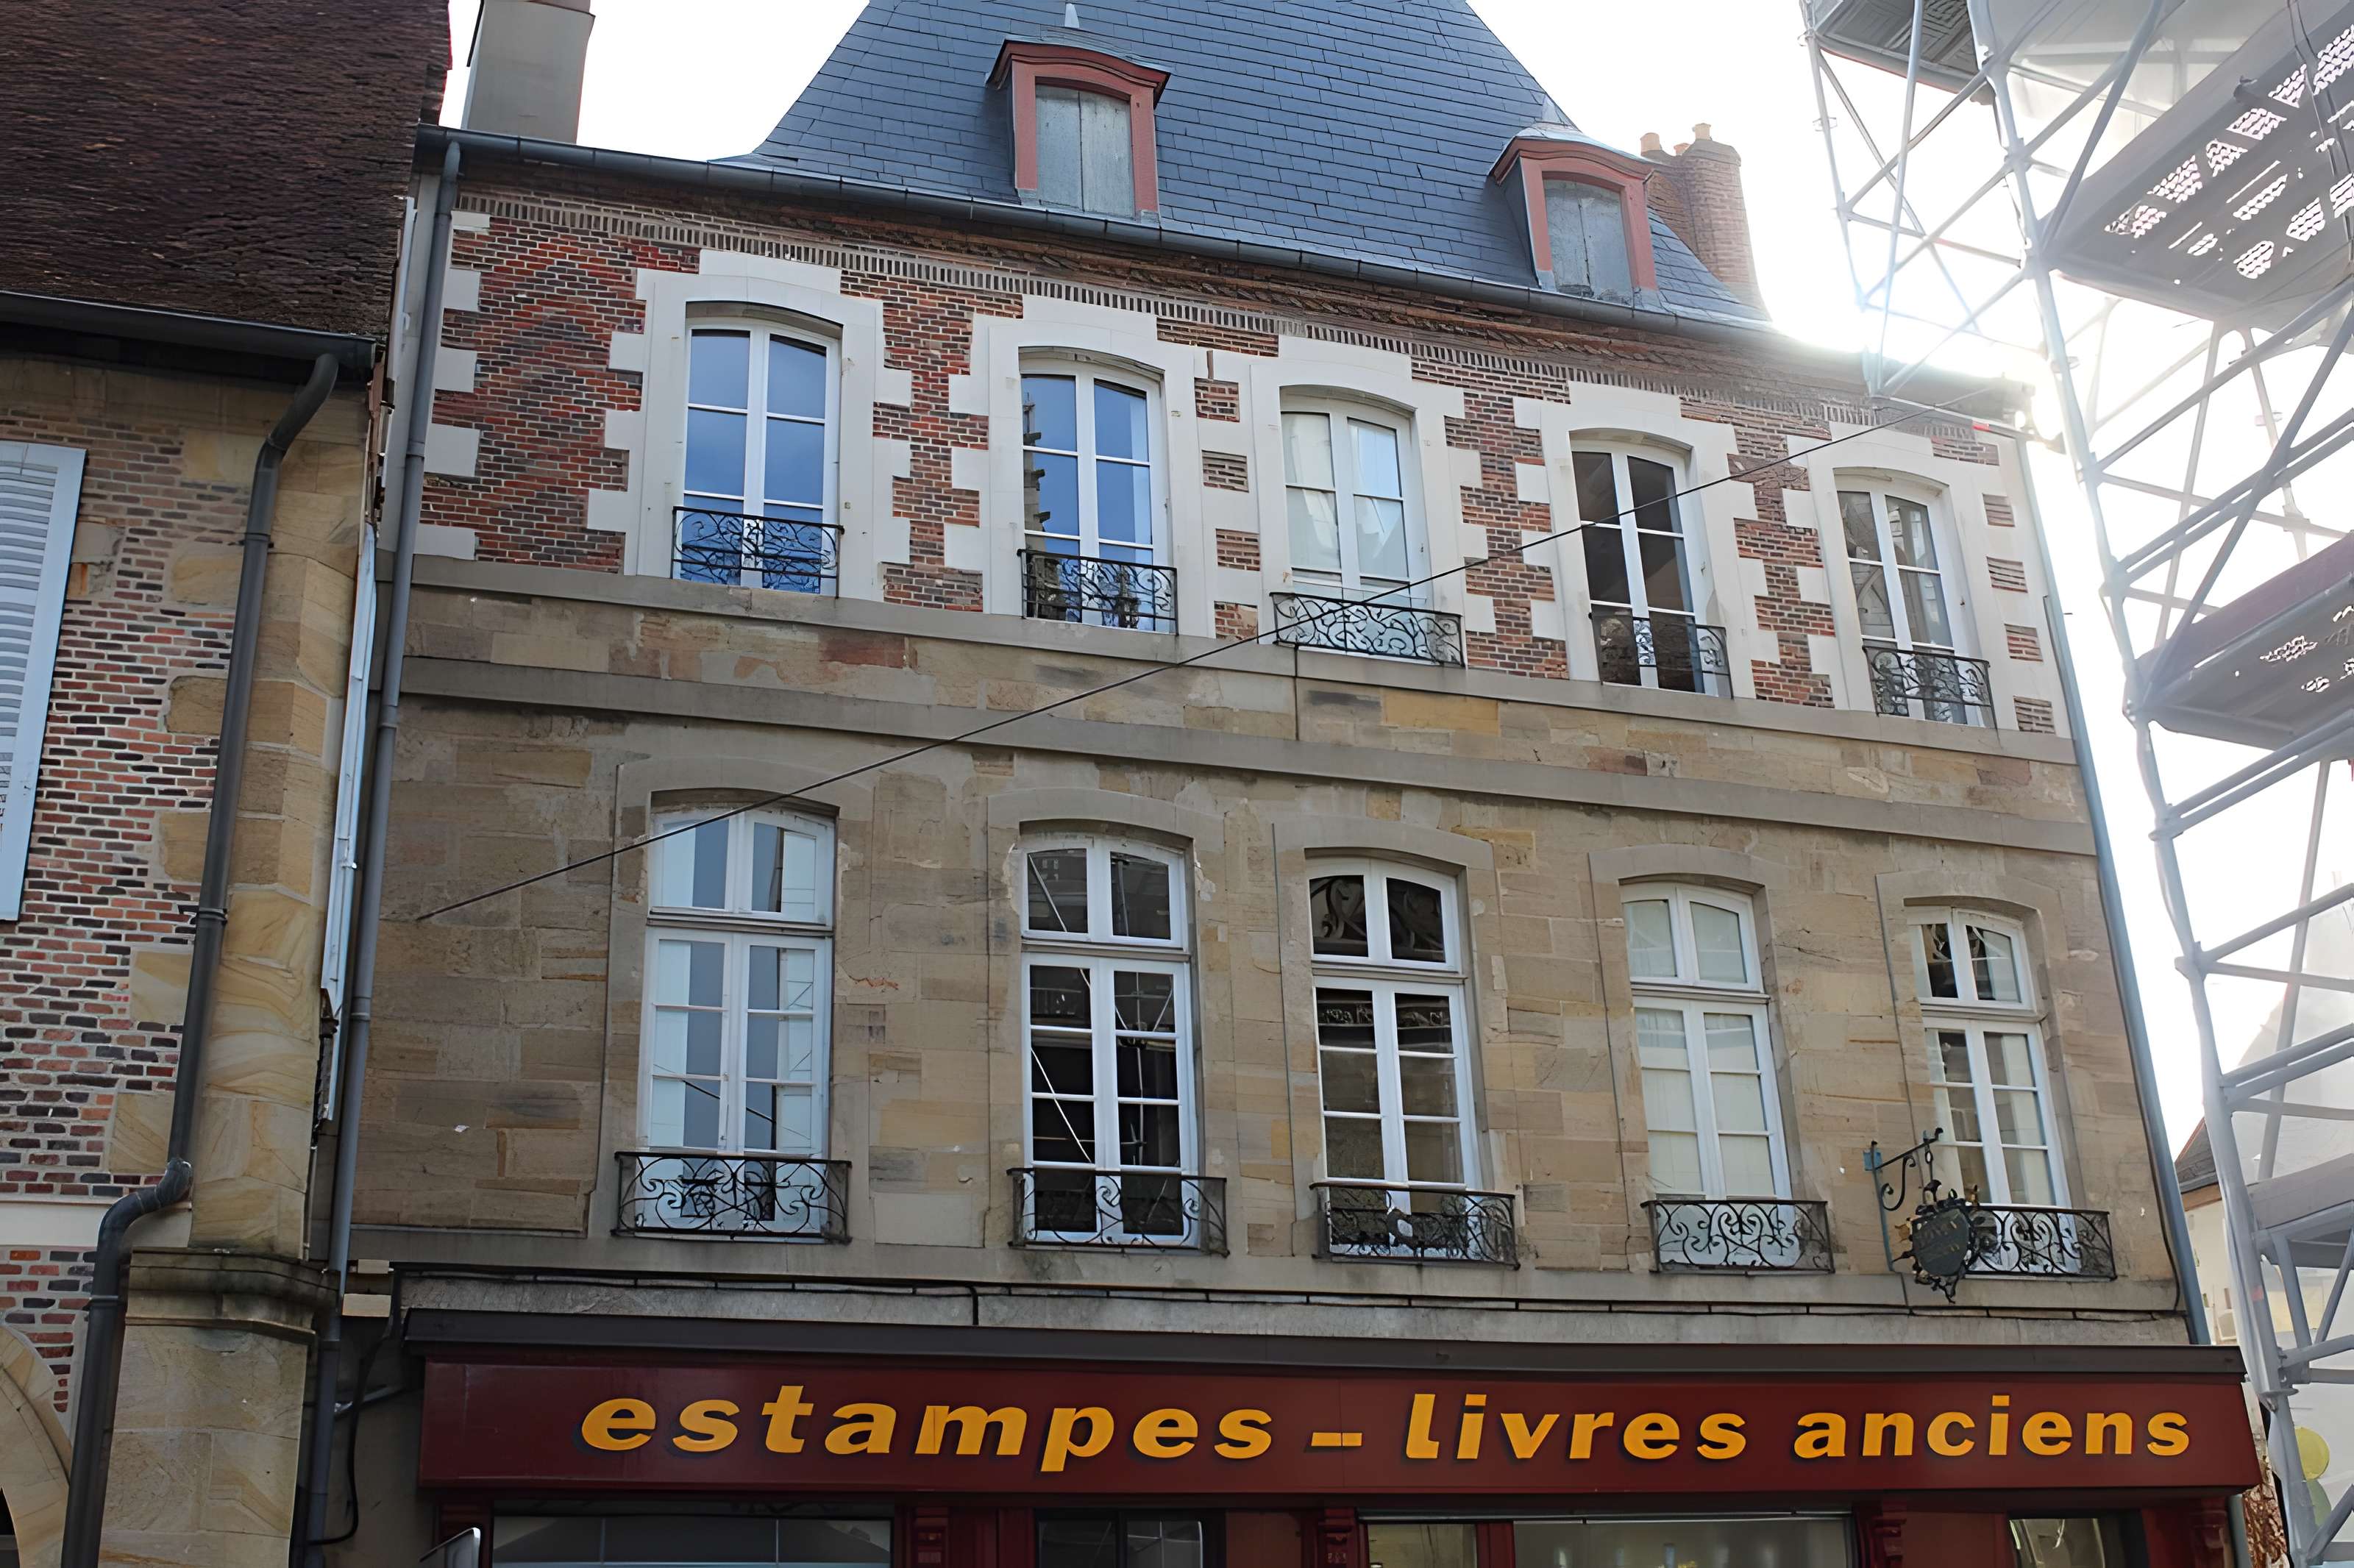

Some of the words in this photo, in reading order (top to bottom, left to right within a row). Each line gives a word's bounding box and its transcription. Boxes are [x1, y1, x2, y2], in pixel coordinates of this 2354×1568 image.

[582, 1386, 1273, 1472] estampes
[1406, 1393, 1747, 1460] livres
[1793, 1394, 2190, 1458] anciens
